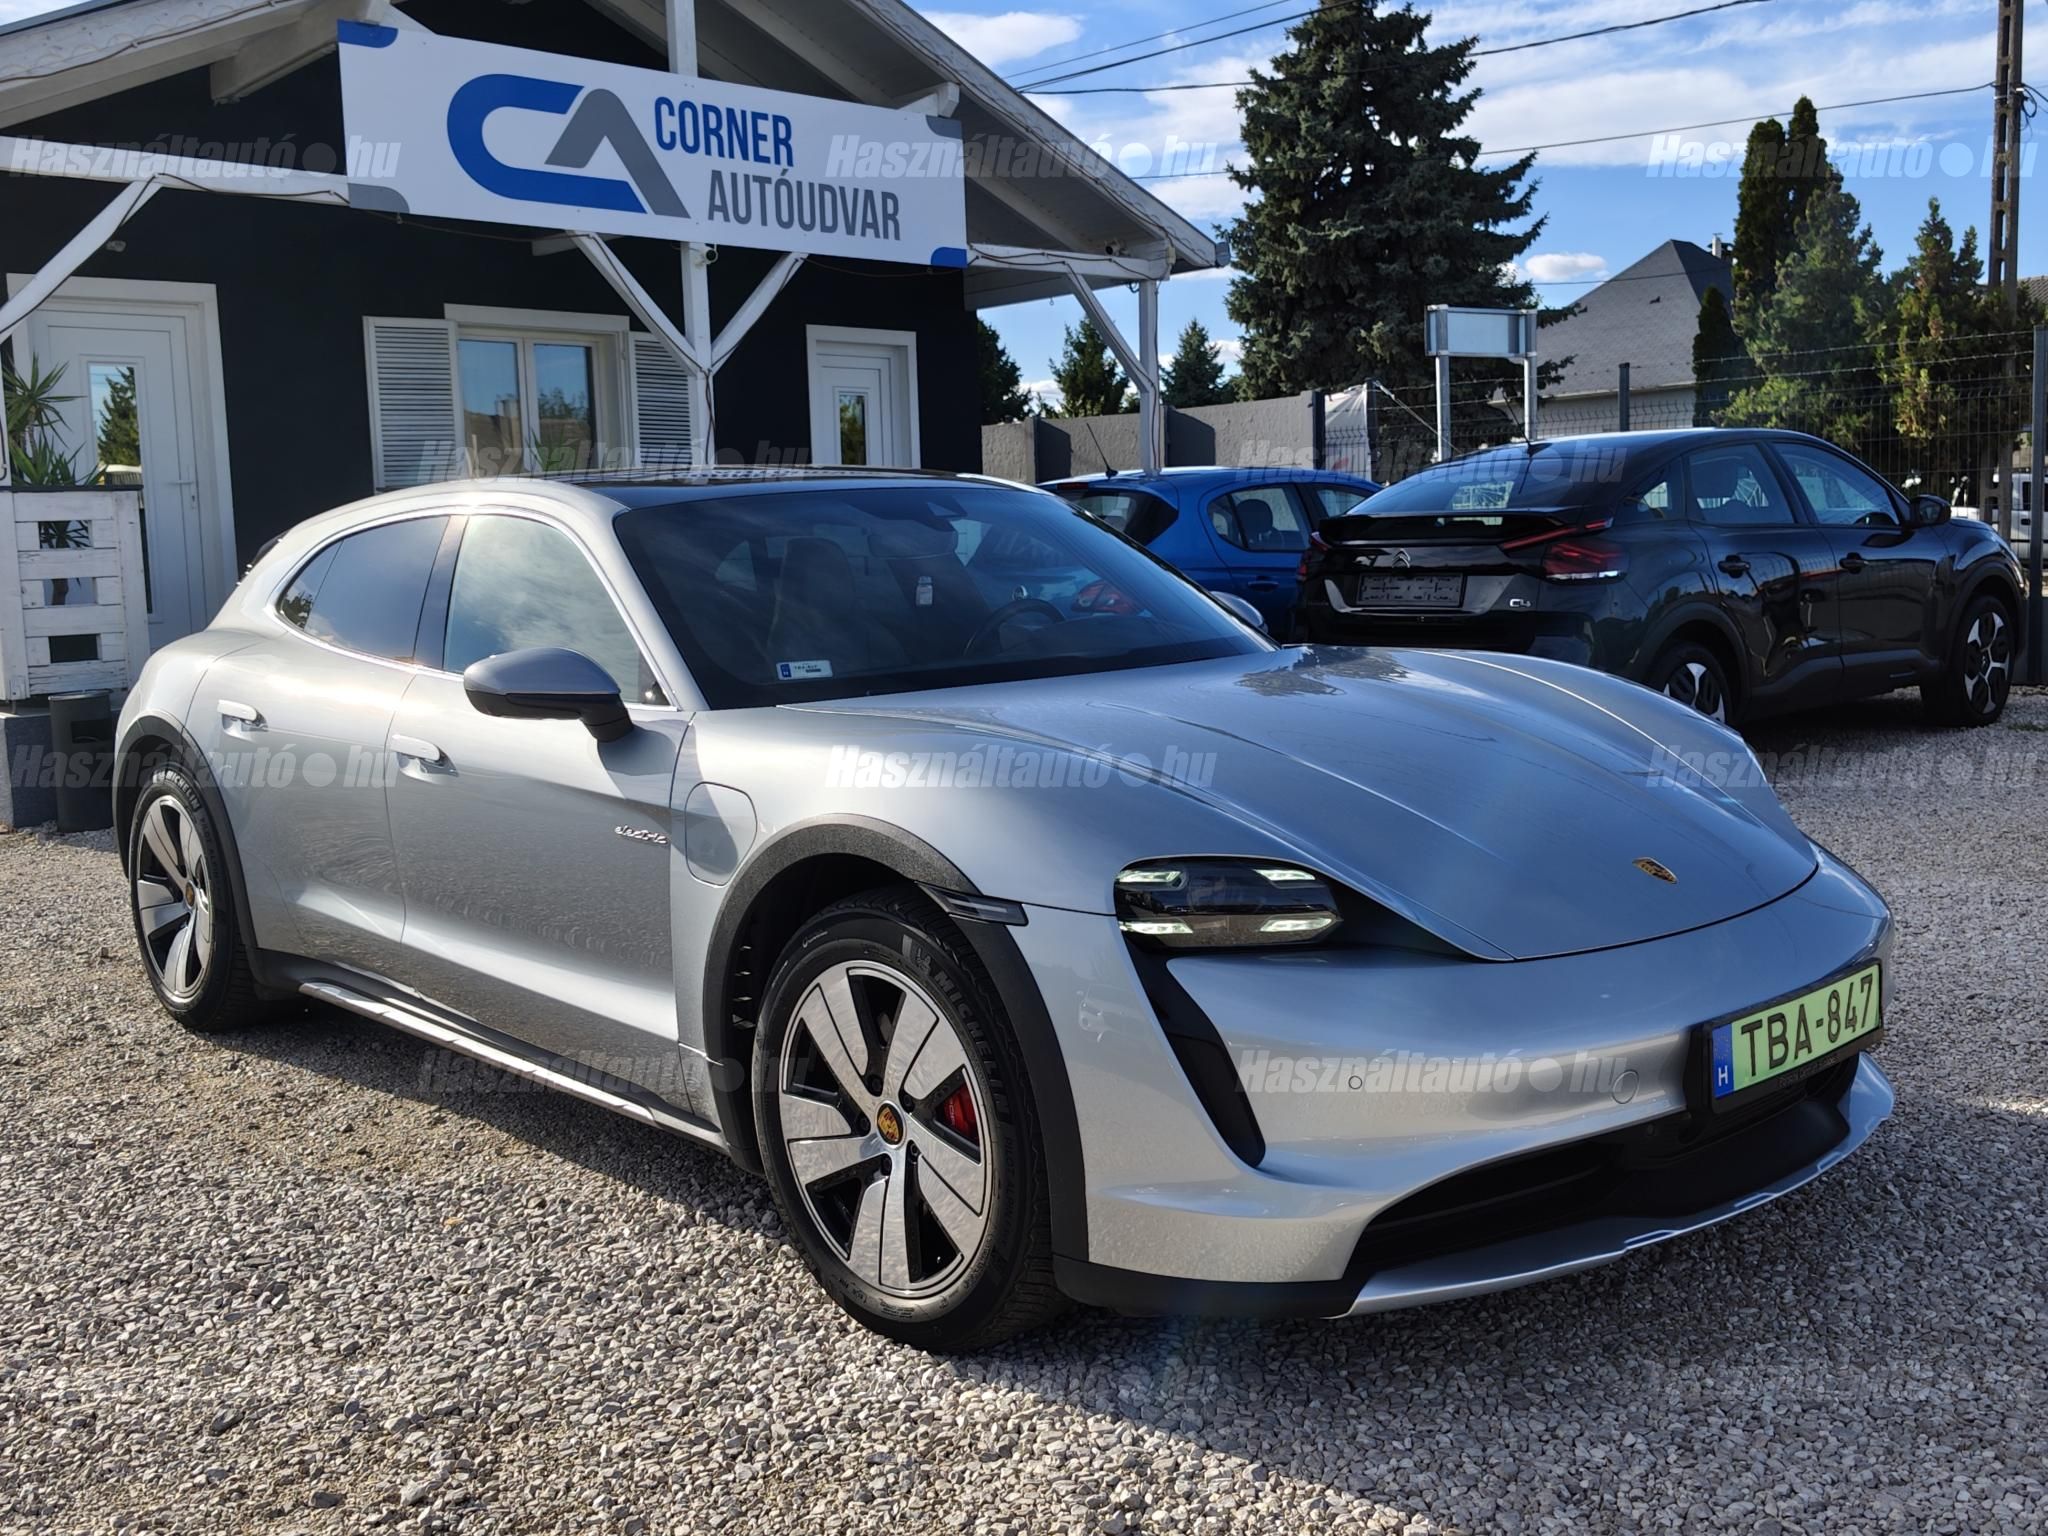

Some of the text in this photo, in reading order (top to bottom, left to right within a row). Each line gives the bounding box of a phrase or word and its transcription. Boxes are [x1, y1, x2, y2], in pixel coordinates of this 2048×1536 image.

[447, 73, 692, 219] CA
[654, 96, 794, 168] CORNER
[707, 168, 901, 241] AUTÓUDVAR
[165, 770, 201, 811] MICHELIN
[614, 824, 668, 844] electric
[934, 972, 1013, 1119] MICHELIN
[1740, 973, 1873, 1077] TBA-847
[1718, 1065, 1729, 1087] H
